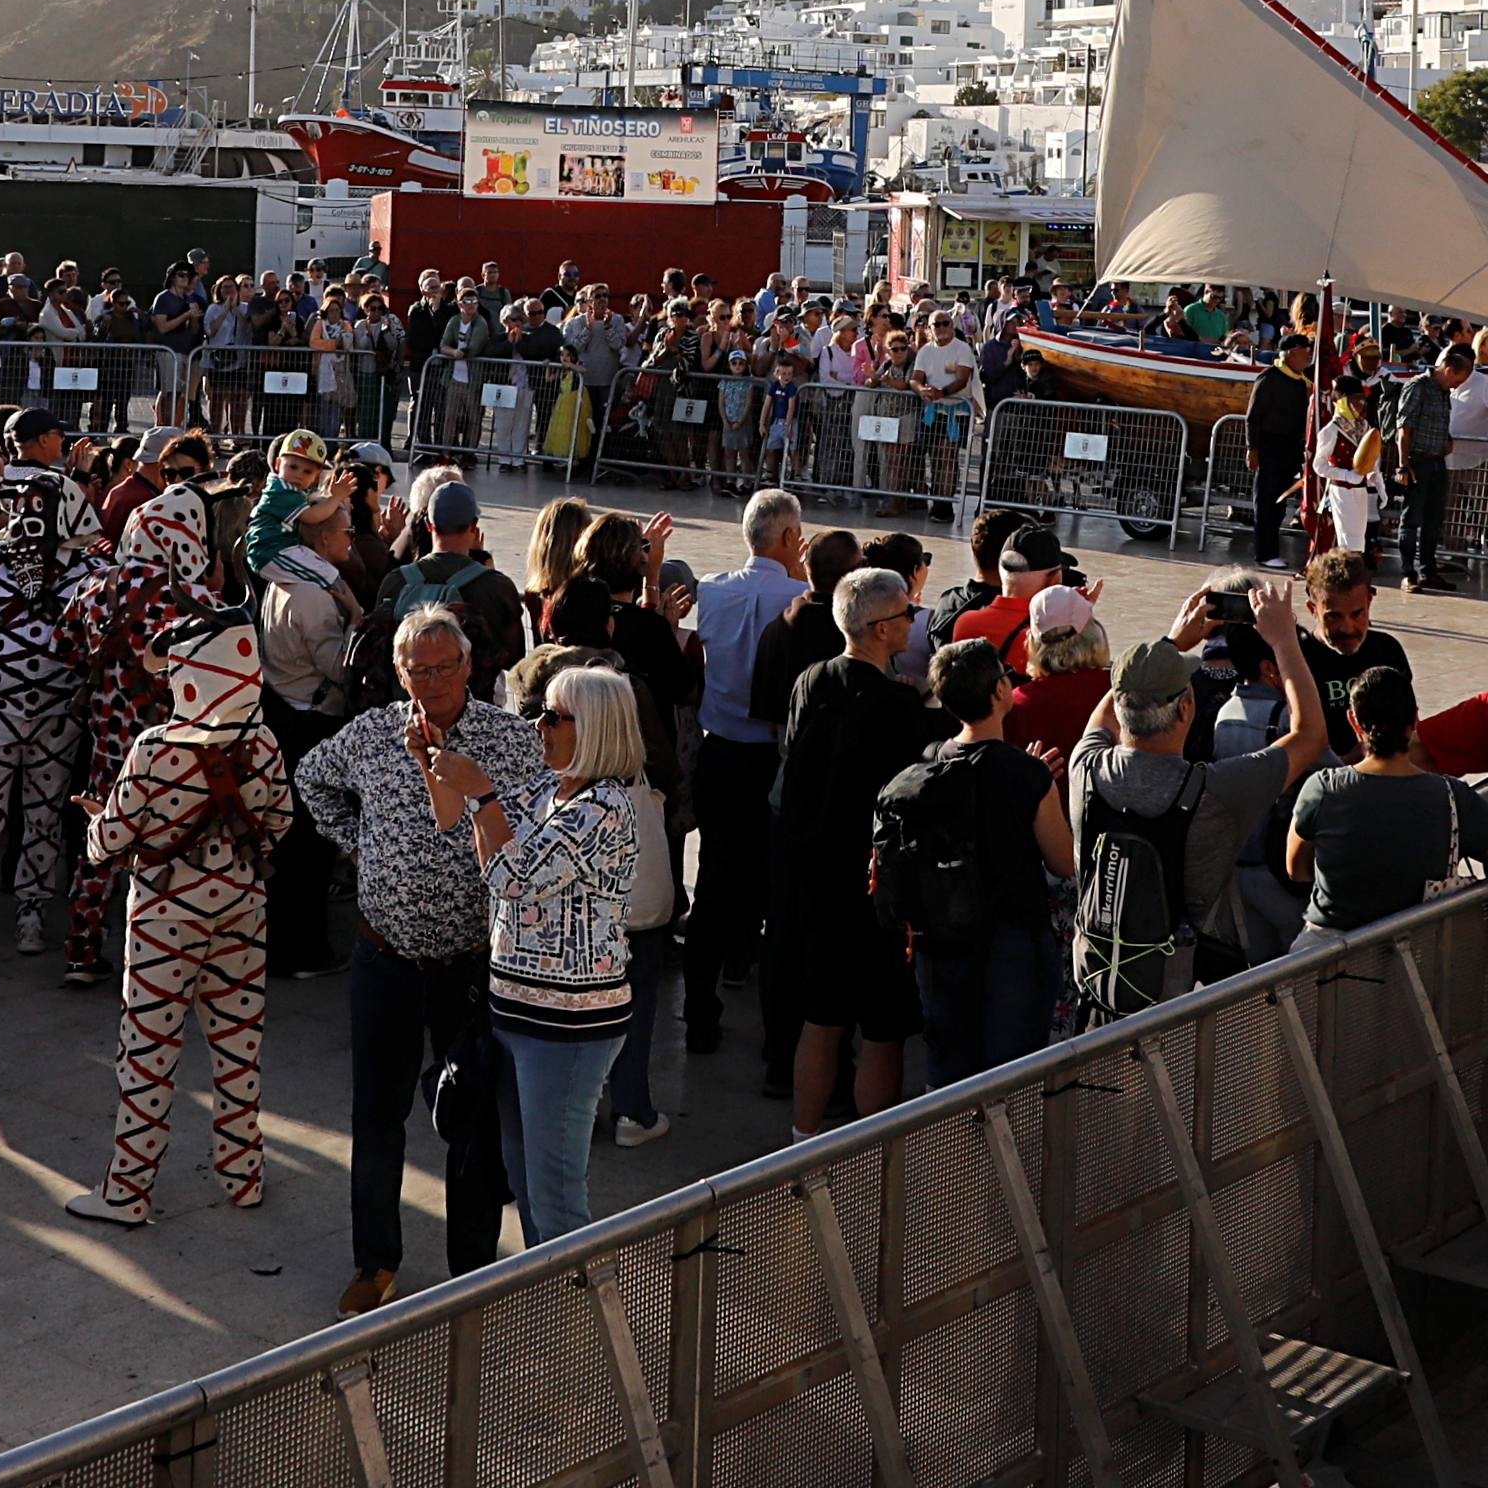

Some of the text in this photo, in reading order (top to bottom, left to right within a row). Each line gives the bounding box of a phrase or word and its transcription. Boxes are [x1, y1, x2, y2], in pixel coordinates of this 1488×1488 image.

[689, 90, 704, 99] GH
[855, 99, 869, 108] GH
[490, 111, 532, 126] Tropical
[543, 114, 661, 138] EL TIÑOSERO
[650, 150, 703, 160] COMBINADOS
[1101, 842, 1121, 912] karrimor
